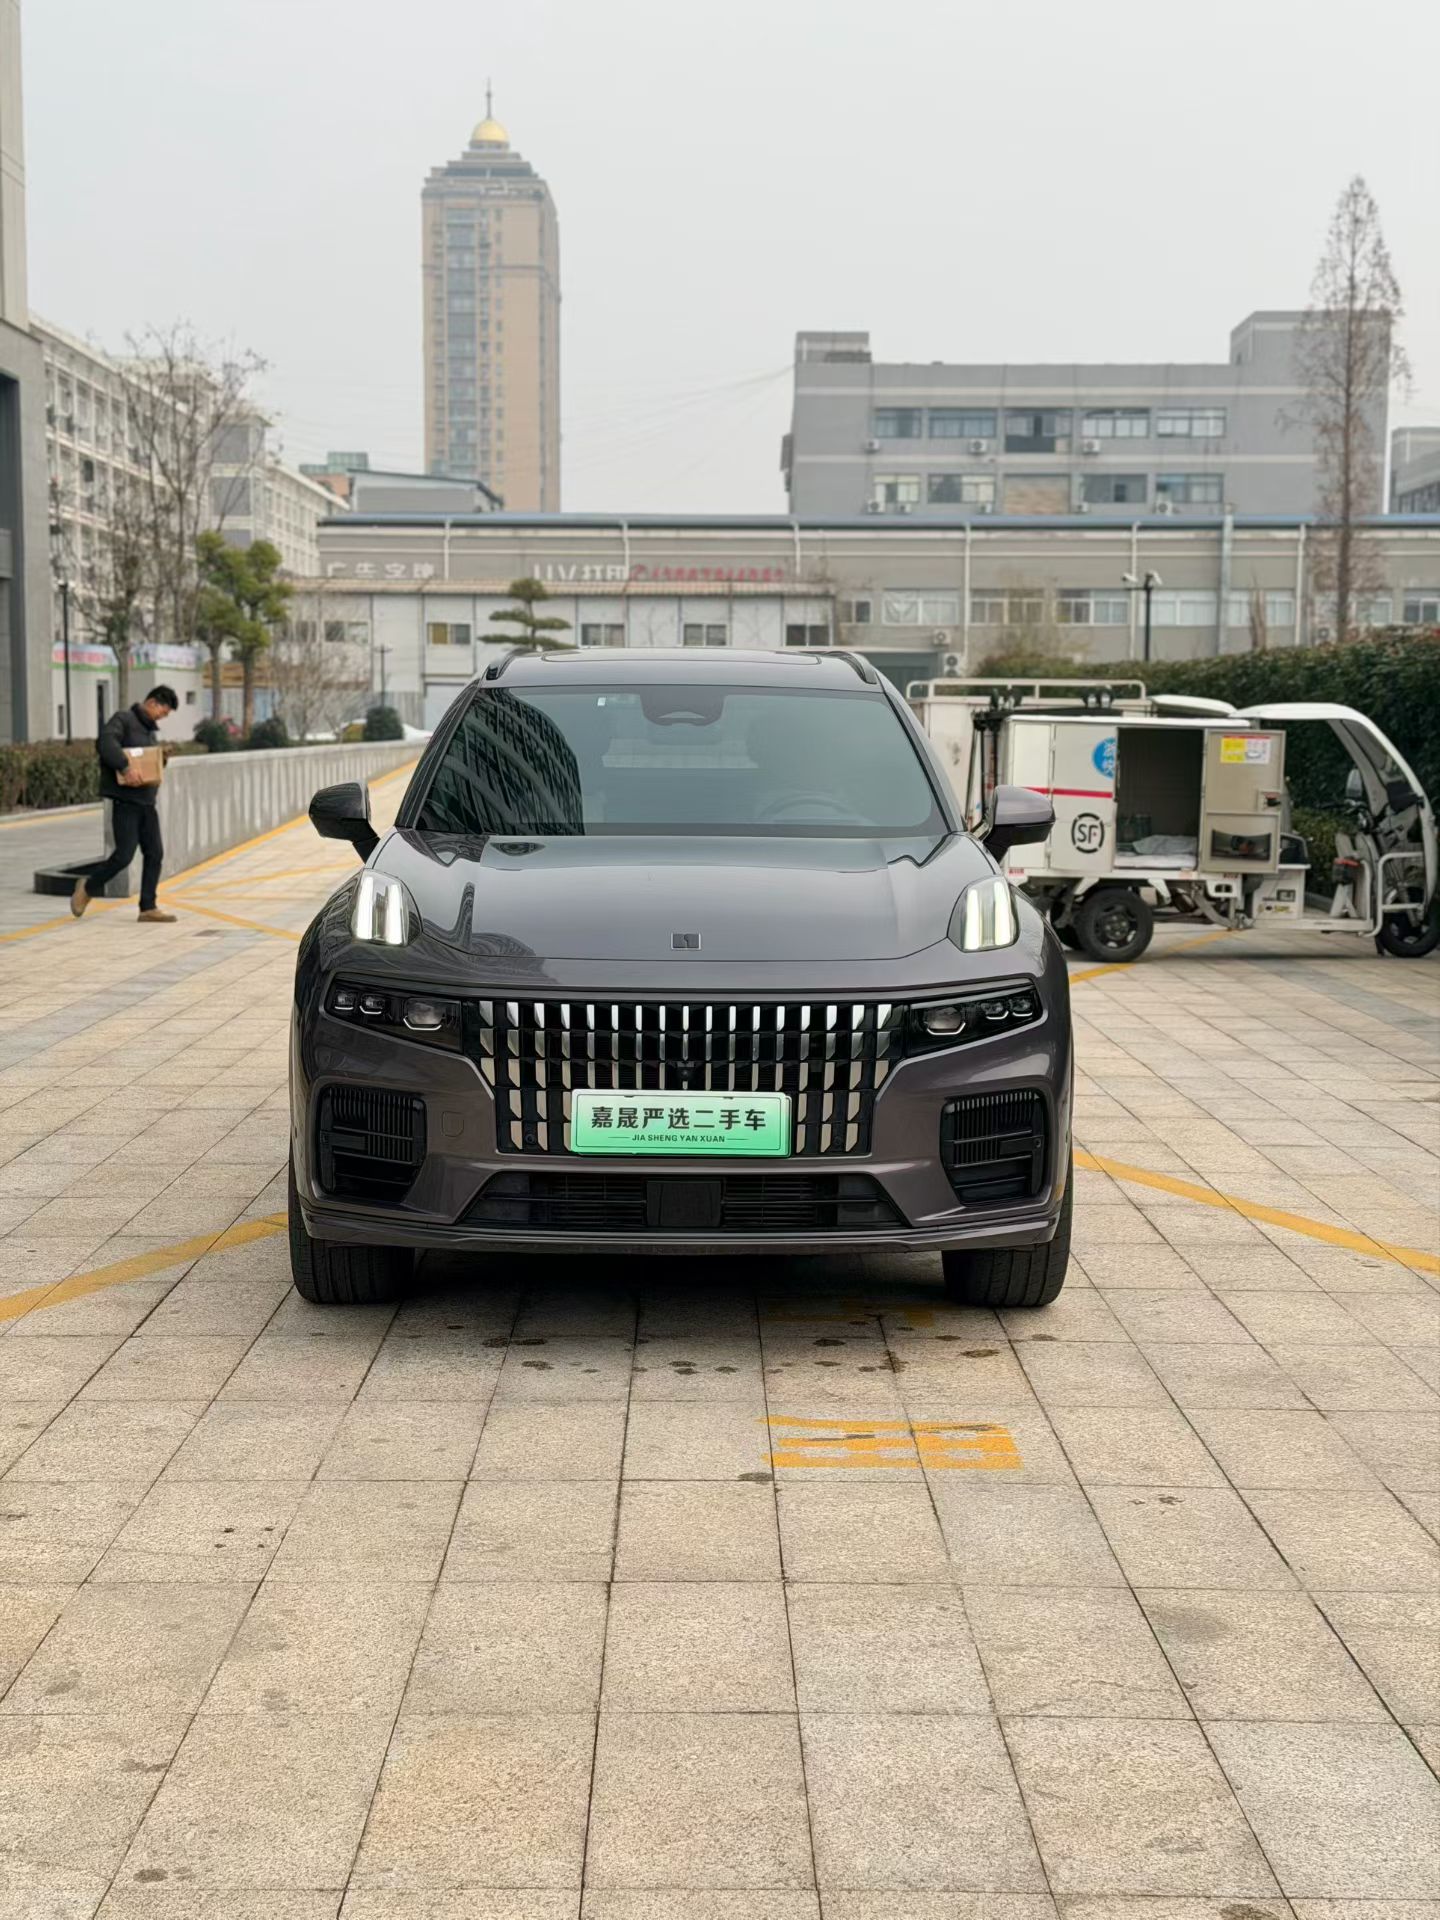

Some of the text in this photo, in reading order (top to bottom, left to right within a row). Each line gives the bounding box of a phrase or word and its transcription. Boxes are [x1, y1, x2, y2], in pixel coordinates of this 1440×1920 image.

[1077, 823, 1099, 844] SF
[591, 1106, 766, 1131] 嘉晟严选二手车
[648, 1134, 678, 1142] SHENG
[700, 1135, 725, 1143] XUAN
